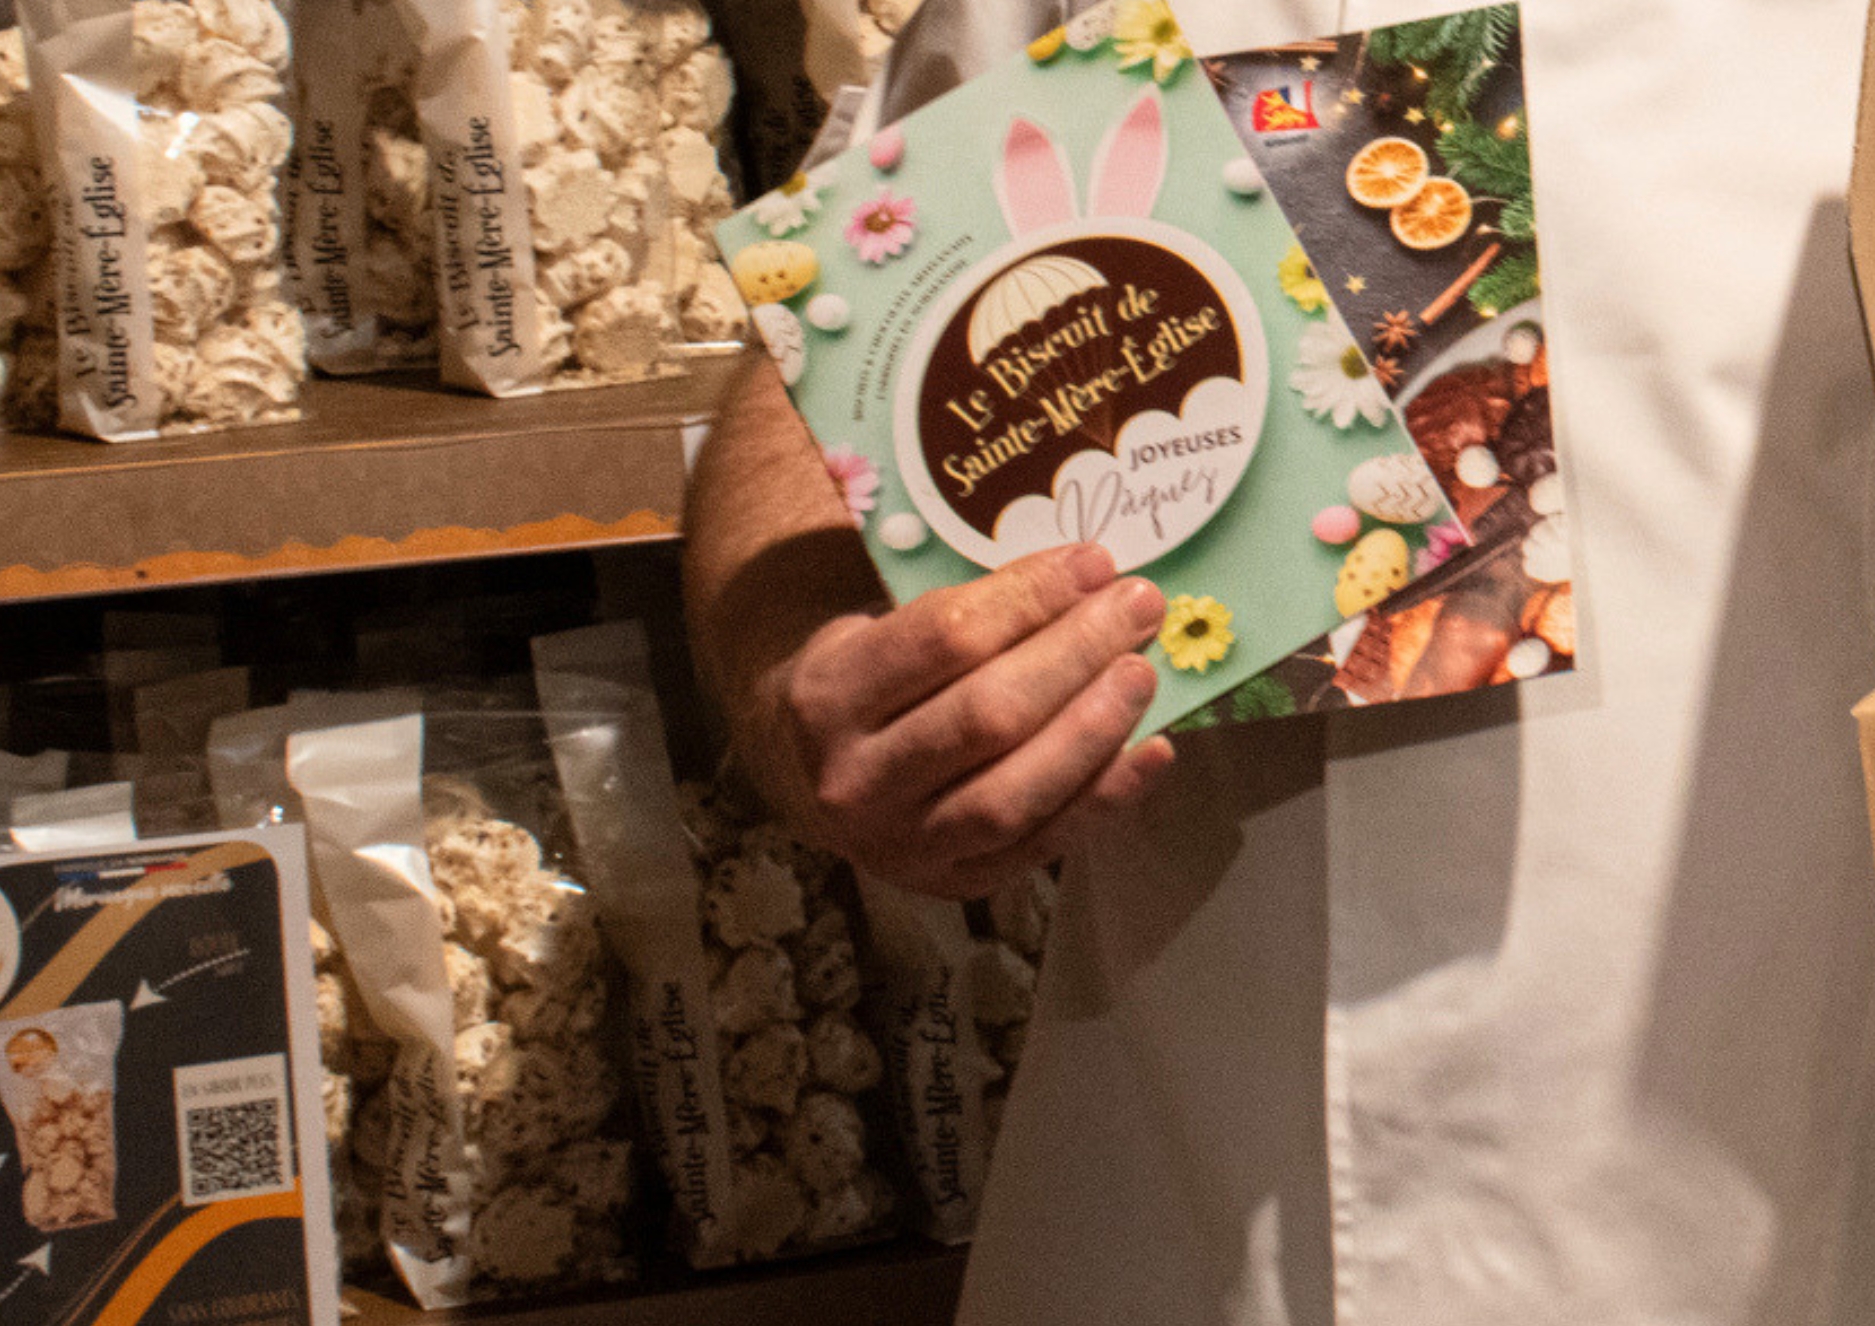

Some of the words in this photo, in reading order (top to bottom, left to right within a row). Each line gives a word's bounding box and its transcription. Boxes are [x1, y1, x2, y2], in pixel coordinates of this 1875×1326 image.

[80, 157, 137, 409] Sainte-Mère-Église
[462, 117, 520, 358] Sainte-Mère-Église
[942, 305, 1222, 498] Sainte-Mère-Église
[946, 388, 995, 432] Le
[986, 304, 1113, 400] Biscuit
[1117, 283, 1160, 322] de
[1129, 425, 1243, 472] JOYEUSES
